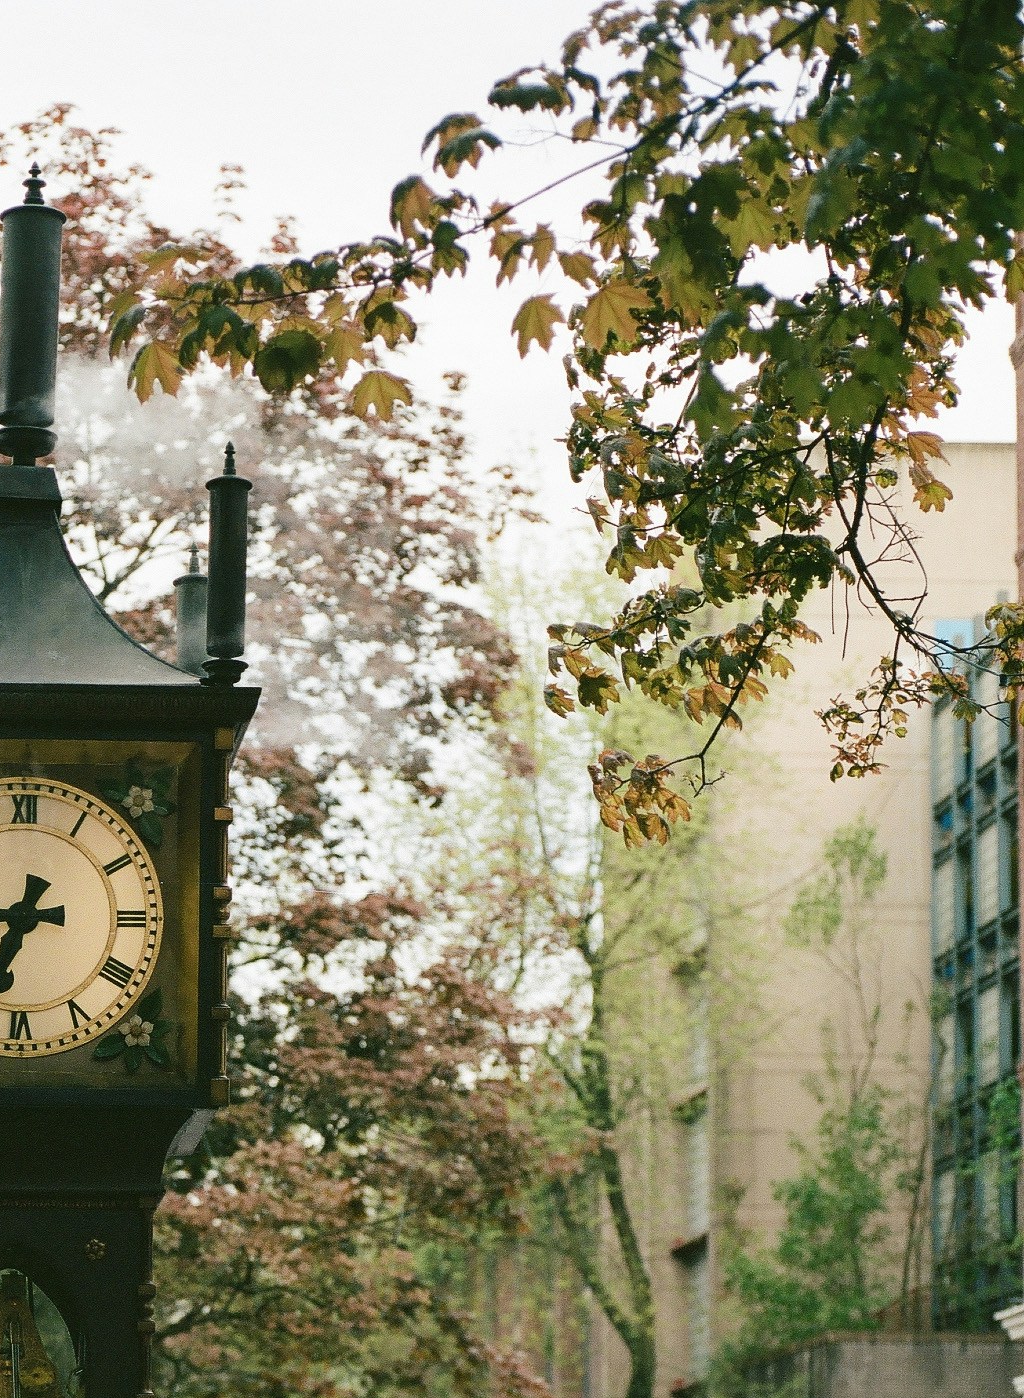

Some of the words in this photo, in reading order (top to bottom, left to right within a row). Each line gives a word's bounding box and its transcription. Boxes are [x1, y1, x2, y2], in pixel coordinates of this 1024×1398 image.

[12, 795, 38, 824] XII
[117, 910, 146, 927] III
[10, 1012, 32, 1040] VI
[68, 999, 91, 1028] V
